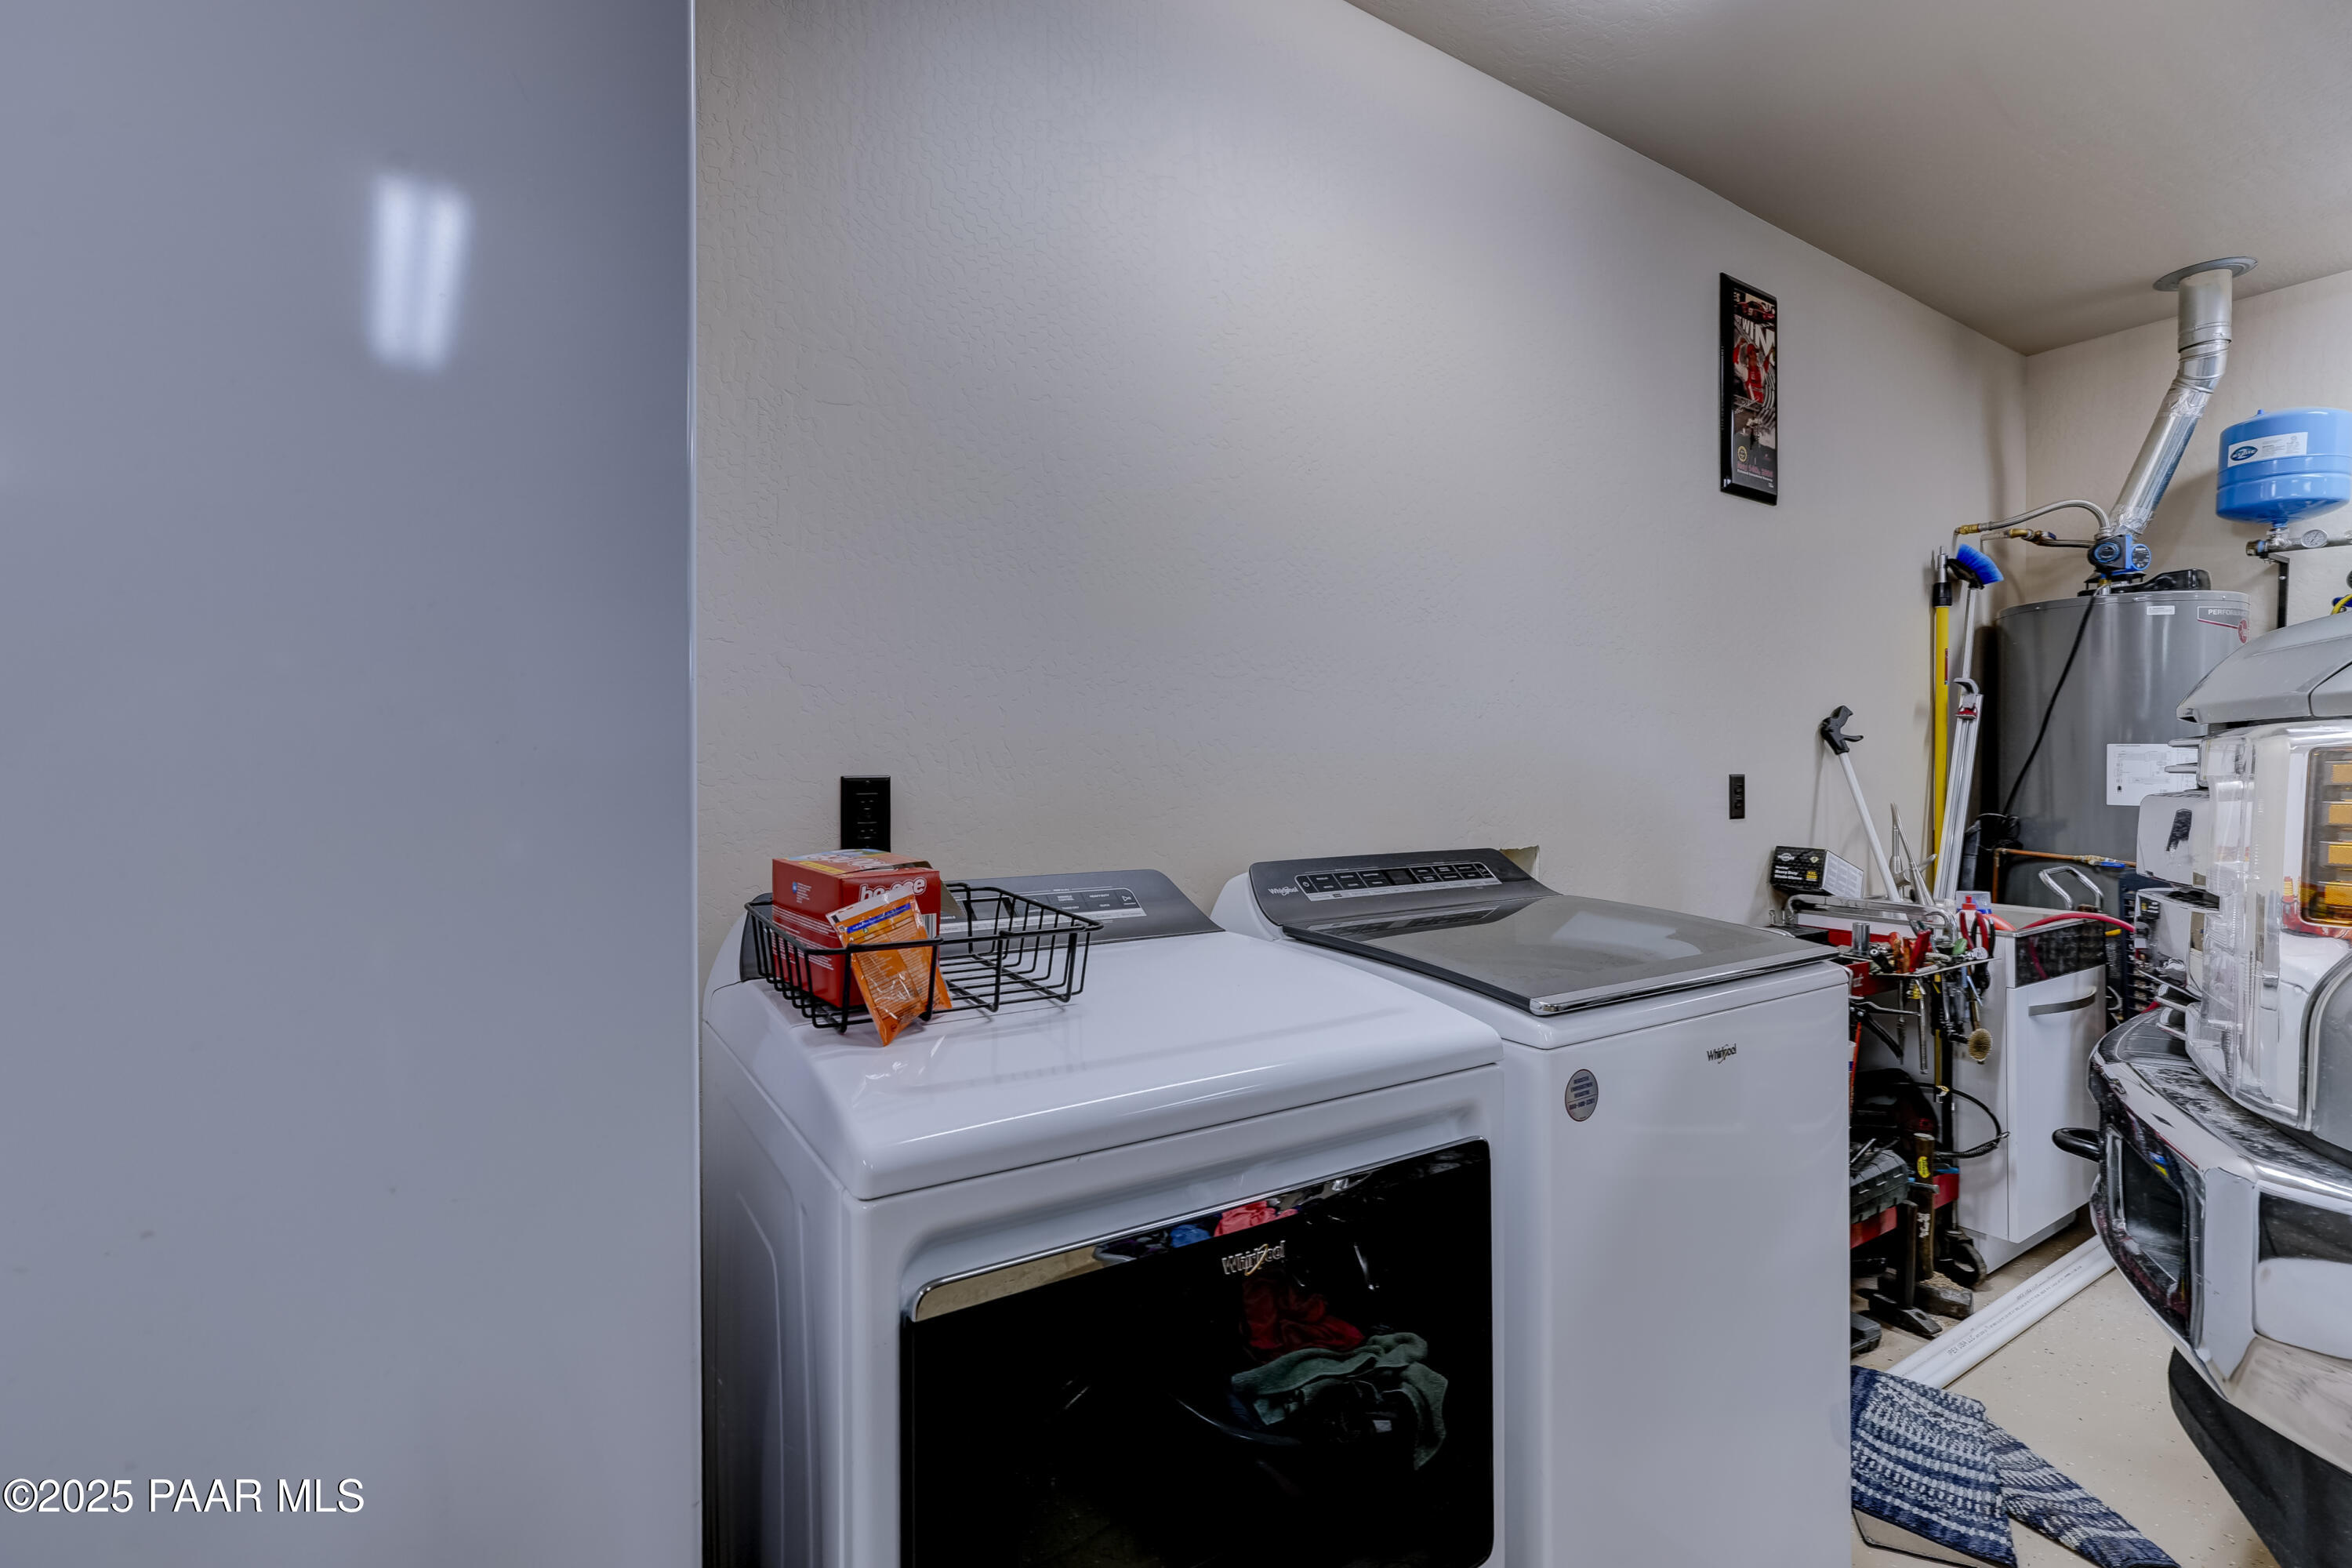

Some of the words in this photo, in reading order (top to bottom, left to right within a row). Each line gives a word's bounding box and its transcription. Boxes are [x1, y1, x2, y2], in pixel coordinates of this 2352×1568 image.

[1268, 886, 1298, 896] Whirlpool
[1706, 1043, 1737, 1064] Whirlpool
[1221, 1240, 1286, 1276] Whirlpool
